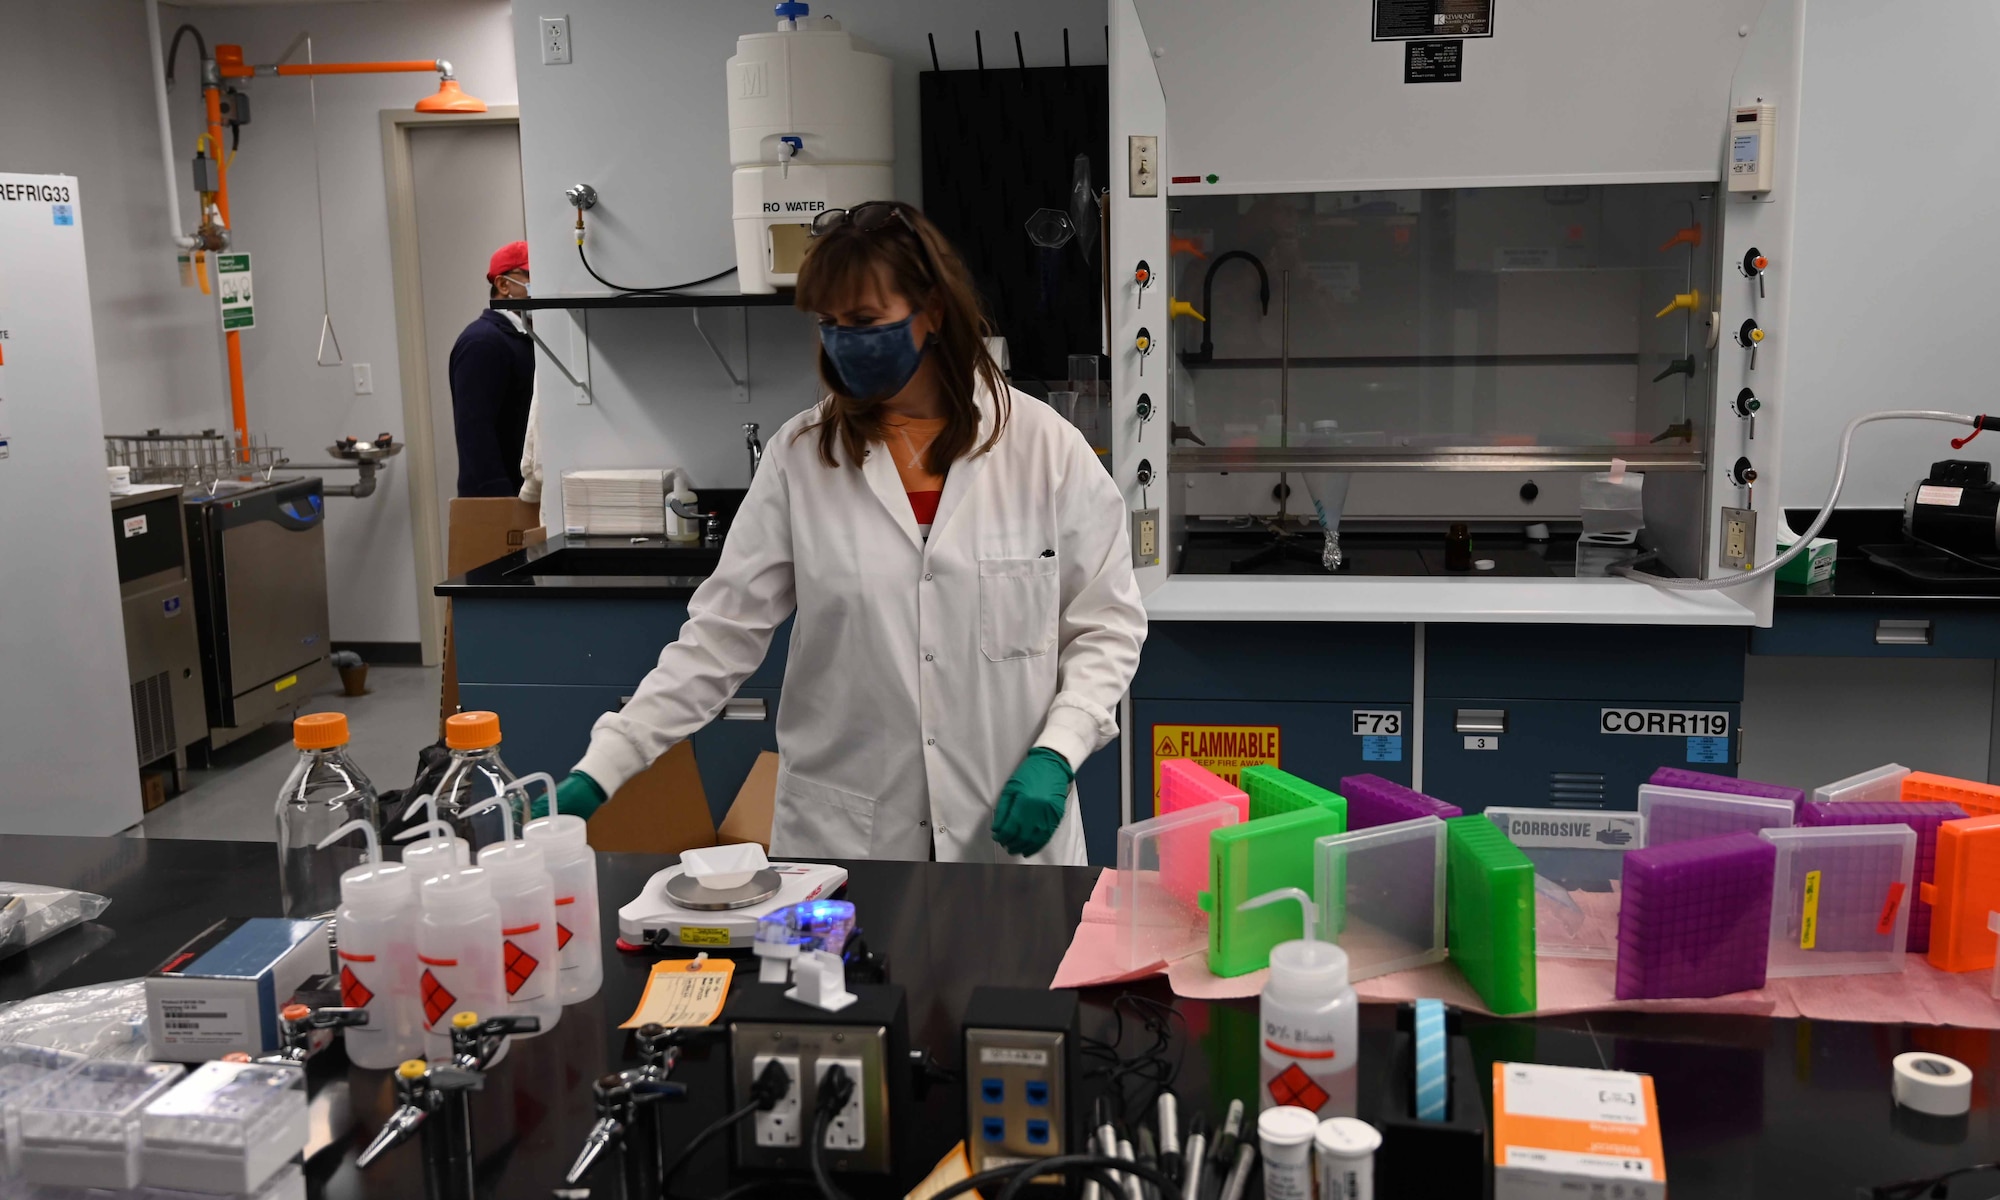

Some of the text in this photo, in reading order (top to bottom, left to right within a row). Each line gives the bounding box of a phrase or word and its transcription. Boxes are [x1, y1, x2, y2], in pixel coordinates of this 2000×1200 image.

[0, 184, 70, 203] REFRIG33
[763, 201, 825, 212] RO WATER
[1353, 713, 1399, 734] F73
[1602, 711, 1727, 735] CORR119
[1181, 731, 1276, 758] FLAMMABLE
[1477, 738, 1485, 749] 3
[1512, 820, 1591, 837] CORROSIVE
